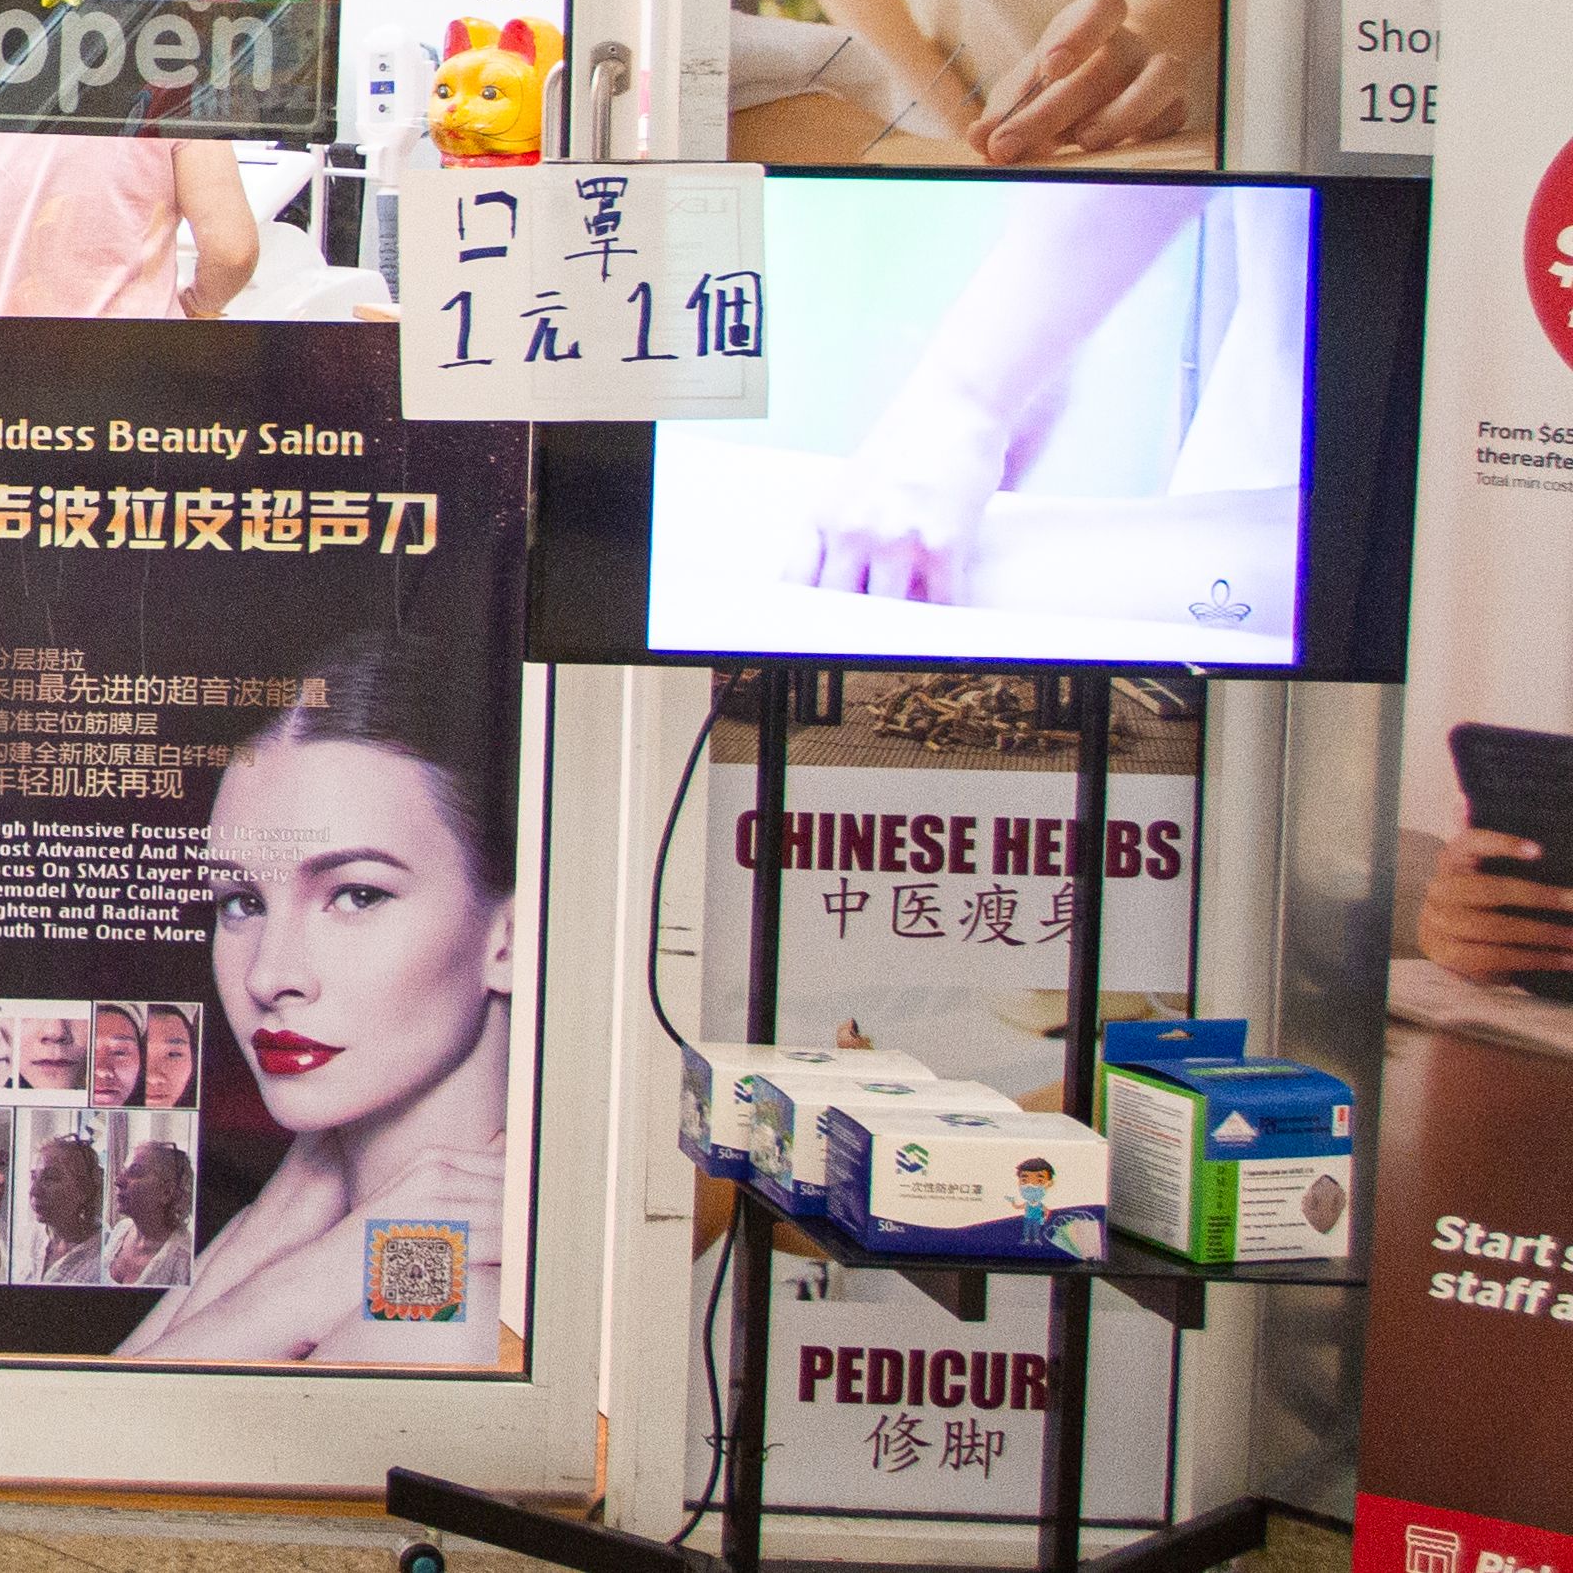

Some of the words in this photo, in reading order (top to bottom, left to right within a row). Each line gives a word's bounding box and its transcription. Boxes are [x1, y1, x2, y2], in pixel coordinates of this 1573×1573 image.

[1357, 18, 1441, 62] Sho
[457, 175, 638, 283] 口罩
[439, 270, 763, 369] 1元1個
[109, 420, 248, 460] Beauty
[258, 423, 364, 456] Salon
[1478, 421, 1533, 441] From
[1474, 472, 1508, 487] Total
[33, 821, 125, 839] Intensive
[131, 823, 212, 840] Focused
[36, 842, 133, 859] Advanced
[140, 843, 177, 860] And
[184, 845, 251, 861] Nature
[43, 862, 70, 879] On
[77, 863, 129, 880] SMAS
[136, 865, 191, 885] Layer
[197, 866, 290, 886] Precisely
[73, 882, 121, 900] Your
[127, 884, 213, 904] Collagen
[59, 903, 95, 920] and
[102, 904, 179, 922] Radiant
[41, 922, 89, 940] Time
[96, 924, 146, 941] Once
[153, 925, 206, 942] More
[900, 1181, 983, 1195] 一次性防护口罩
[1431, 1215, 1556, 1267] Start
[1428, 1270, 1552, 1314] staff
[798, 1345, 1049, 1411] PEDICUR
[864, 1411, 1007, 1480] 修脚
